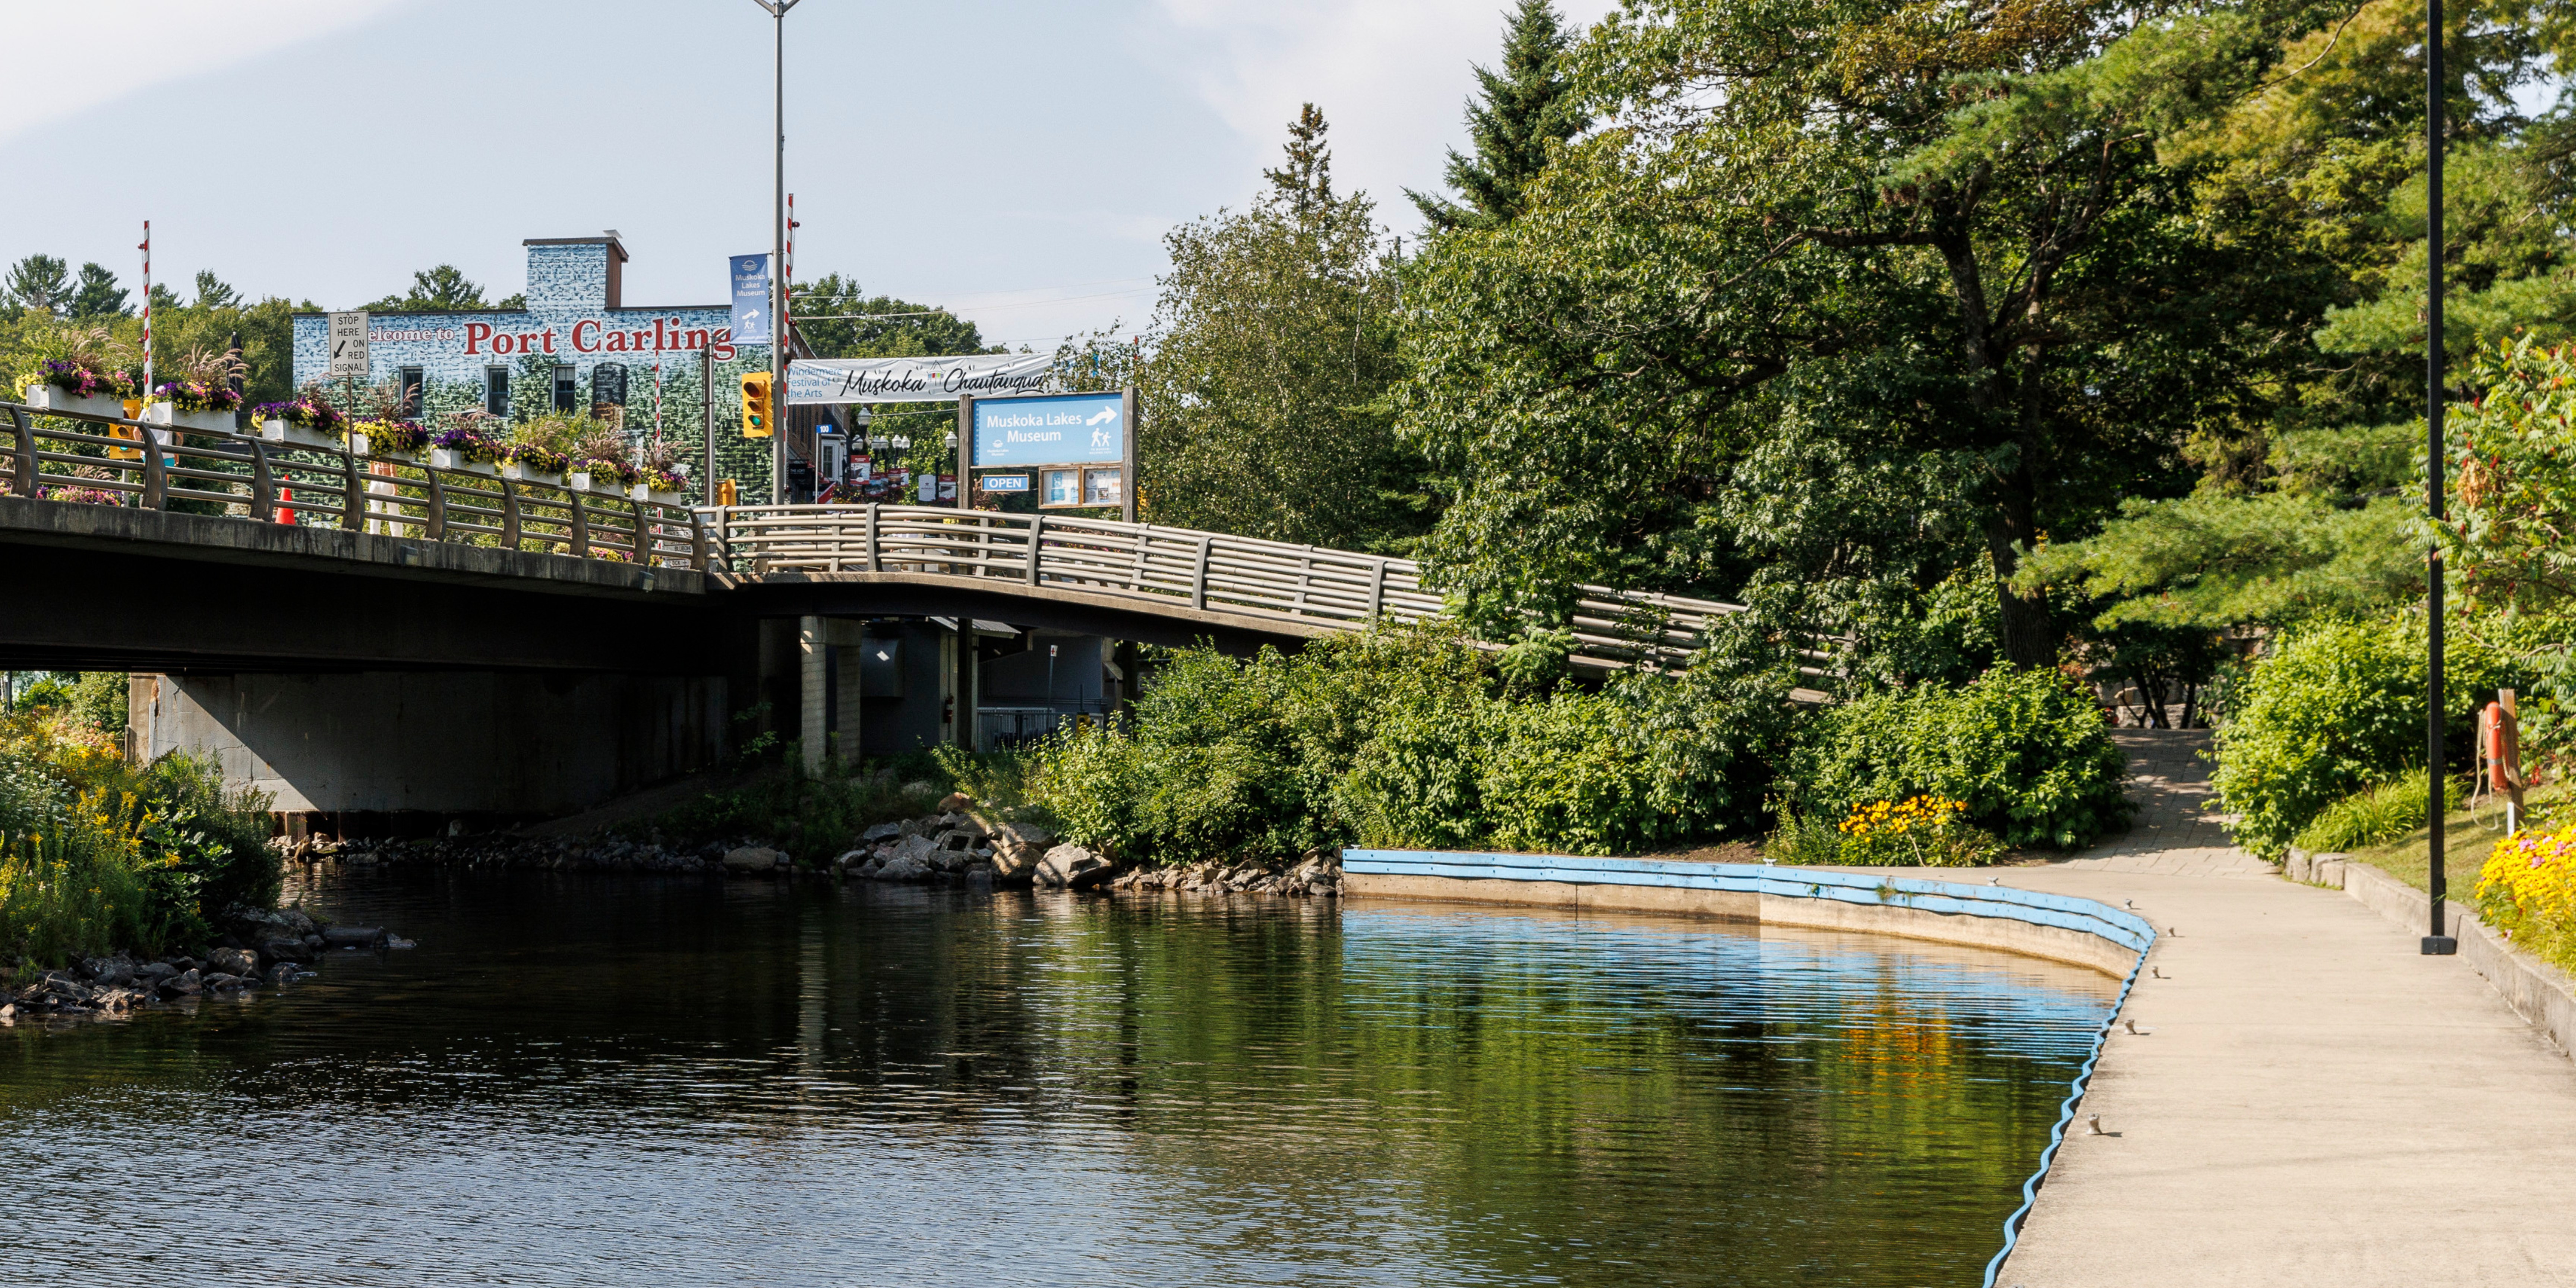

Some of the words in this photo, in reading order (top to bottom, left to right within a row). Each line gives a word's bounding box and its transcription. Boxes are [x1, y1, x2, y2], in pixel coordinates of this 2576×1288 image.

[338, 316, 359, 325] STOP
[337, 328, 359, 337] HERE
[368, 325, 432, 341] elcome
[435, 327, 455, 340] to
[464, 323, 556, 355] Port
[572, 318, 736, 360] Carling
[353, 340, 364, 348] ON
[335, 363, 364, 372] SIGNAL
[822, 377, 831, 386] of
[839, 369, 926, 397] Muskoka
[944, 367, 1045, 395] Chautauqua
[787, 389, 802, 397] the
[804, 389, 823, 397] Arts
[987, 414, 1043, 428] Muskoka
[1046, 412, 1082, 426] Lakes
[1007, 430, 1061, 443] Museum
[989, 477, 1022, 489] OPEN
